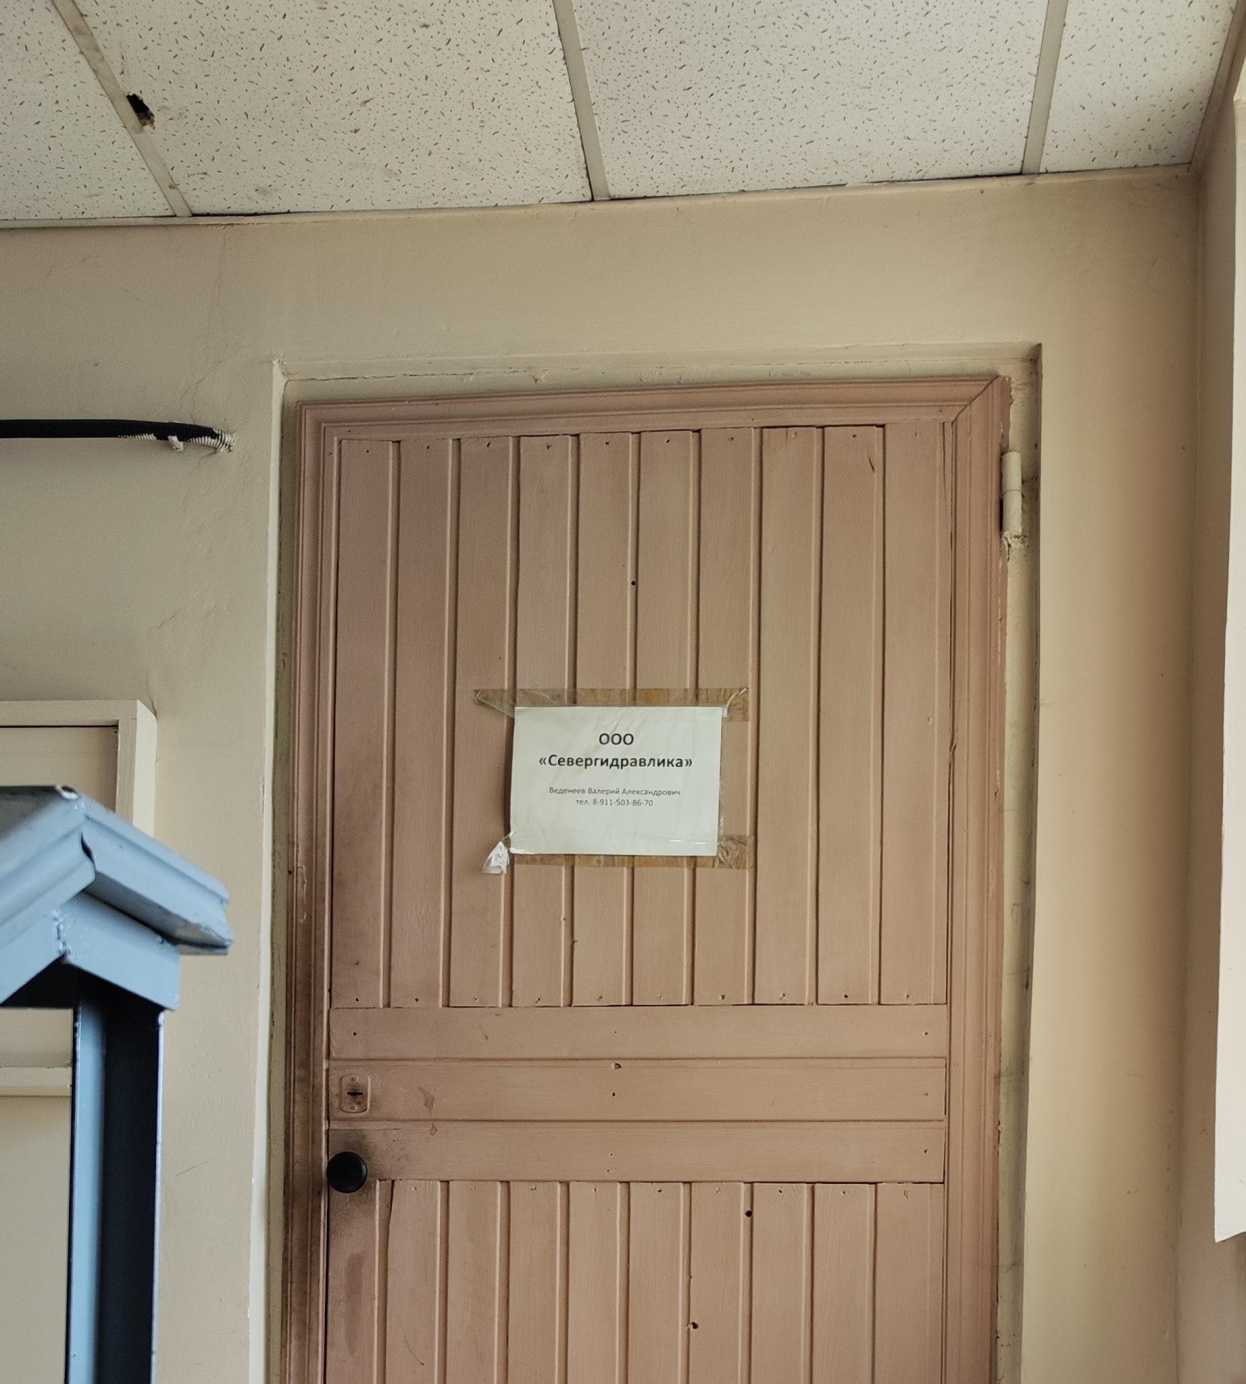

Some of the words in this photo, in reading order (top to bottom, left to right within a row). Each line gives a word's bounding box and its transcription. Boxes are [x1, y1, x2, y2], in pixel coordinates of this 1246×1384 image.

[599, 733, 633, 745] ООО
[539, 754, 693, 770] «Севергидравлика»
[588, 787, 620, 796] Валерий
[622, 788, 681, 797] Александрович
